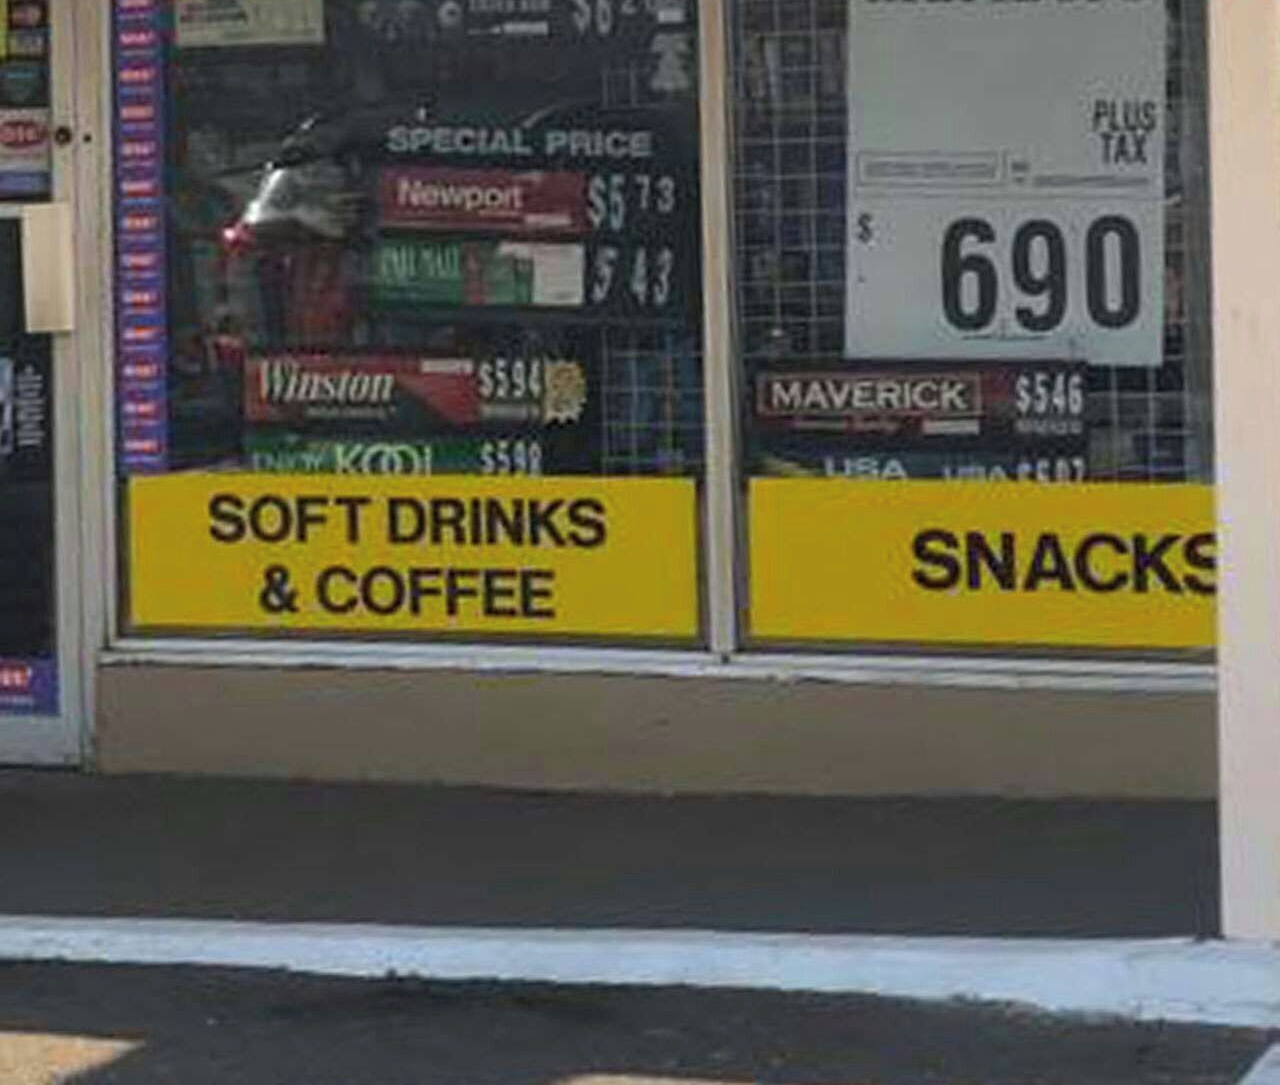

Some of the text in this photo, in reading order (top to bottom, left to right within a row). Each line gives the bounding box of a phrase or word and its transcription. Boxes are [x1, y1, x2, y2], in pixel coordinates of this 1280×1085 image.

[1091, 98, 1156, 132] PLUS
[386, 126, 653, 158] SPECIAL PRICE
[1100, 131, 1148, 165] TAX
[396, 177, 526, 212] Newport
[940, 214, 1142, 333] 690
[258, 358, 395, 404] Winston
[771, 379, 968, 413] MAVERICK
[208, 495, 608, 548] SOFT DRINKS
[259, 564, 556, 619] & COFFEE
